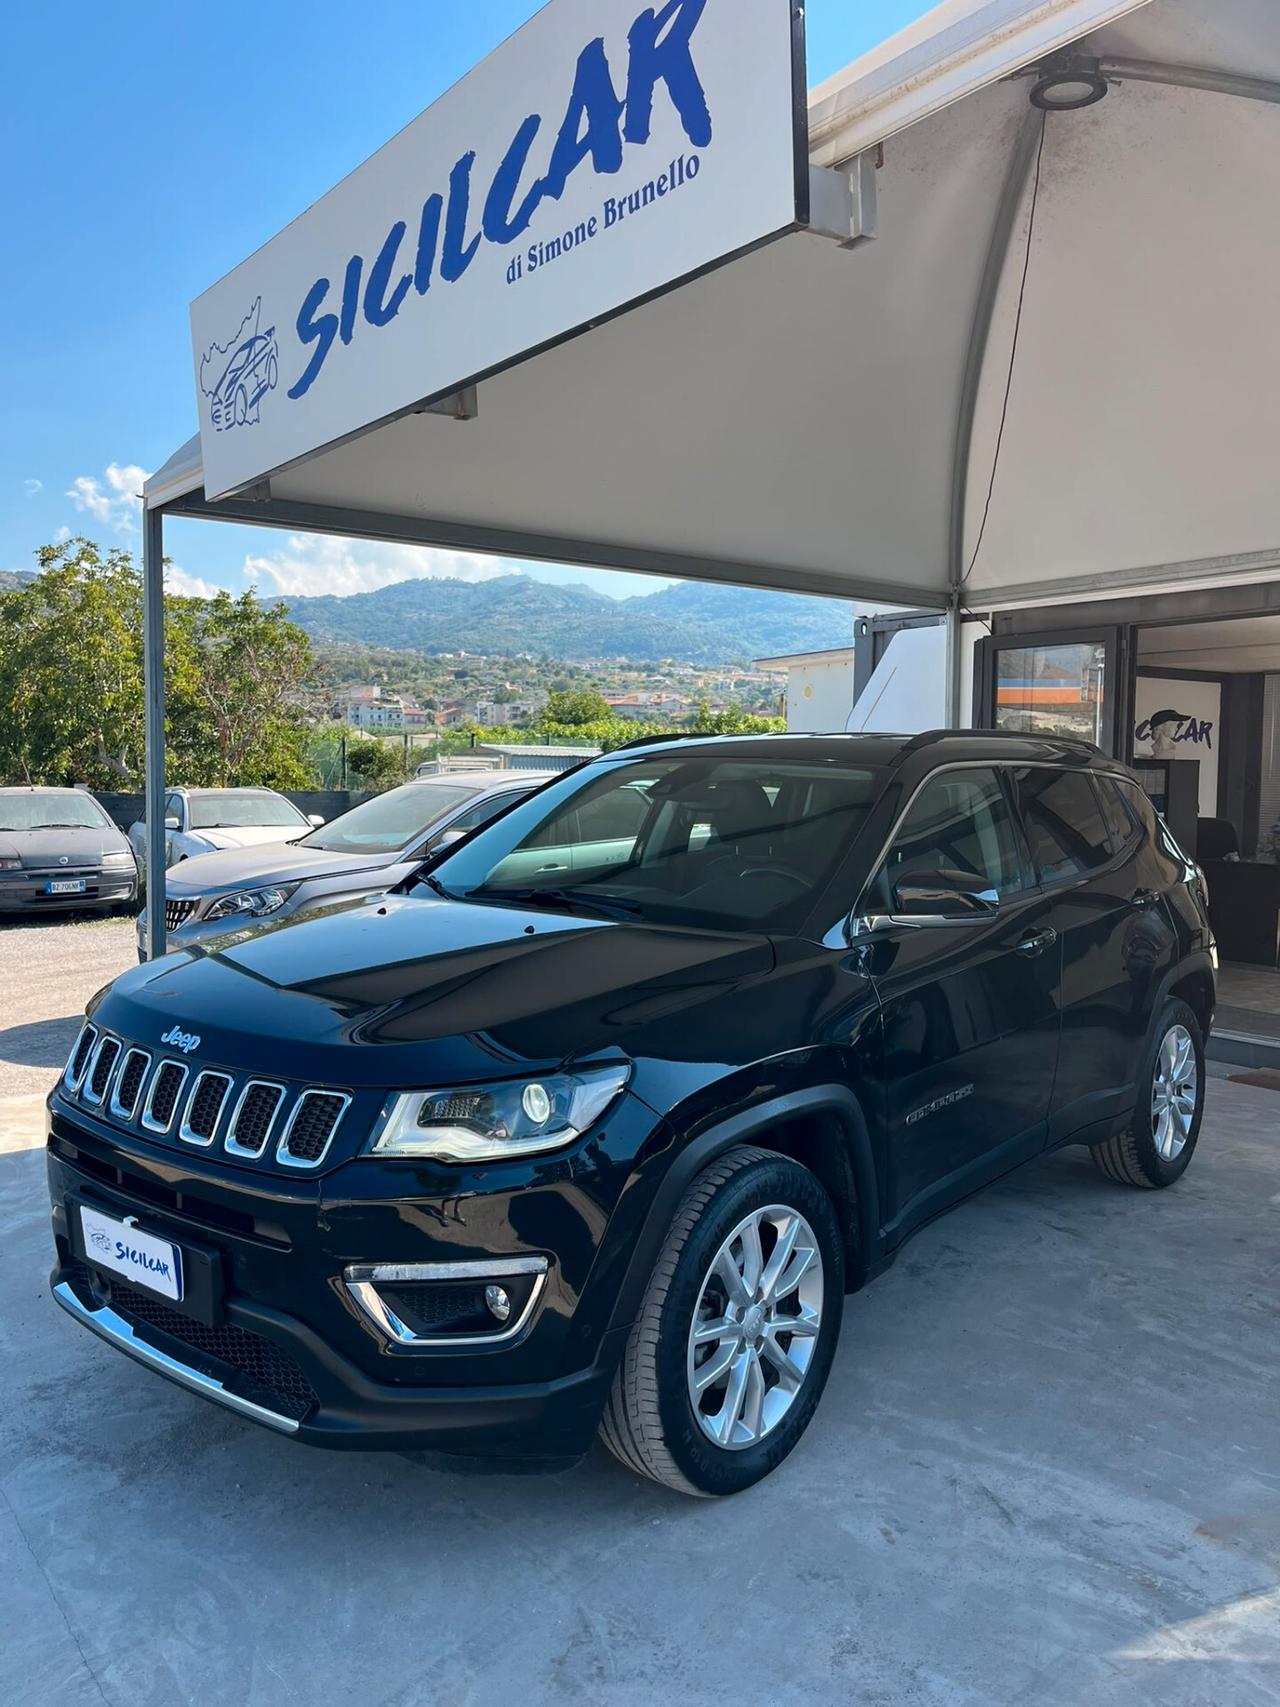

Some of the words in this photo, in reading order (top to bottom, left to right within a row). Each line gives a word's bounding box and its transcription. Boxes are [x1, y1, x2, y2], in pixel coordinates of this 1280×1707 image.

[287, 0, 711, 400] SICILCAR
[506, 254, 522, 284] di
[527, 217, 597, 272] Simone
[603, 153, 700, 229] Brunello
[161, 1026, 200, 1053] Jeep
[115, 1241, 172, 1282] SICILCAR
